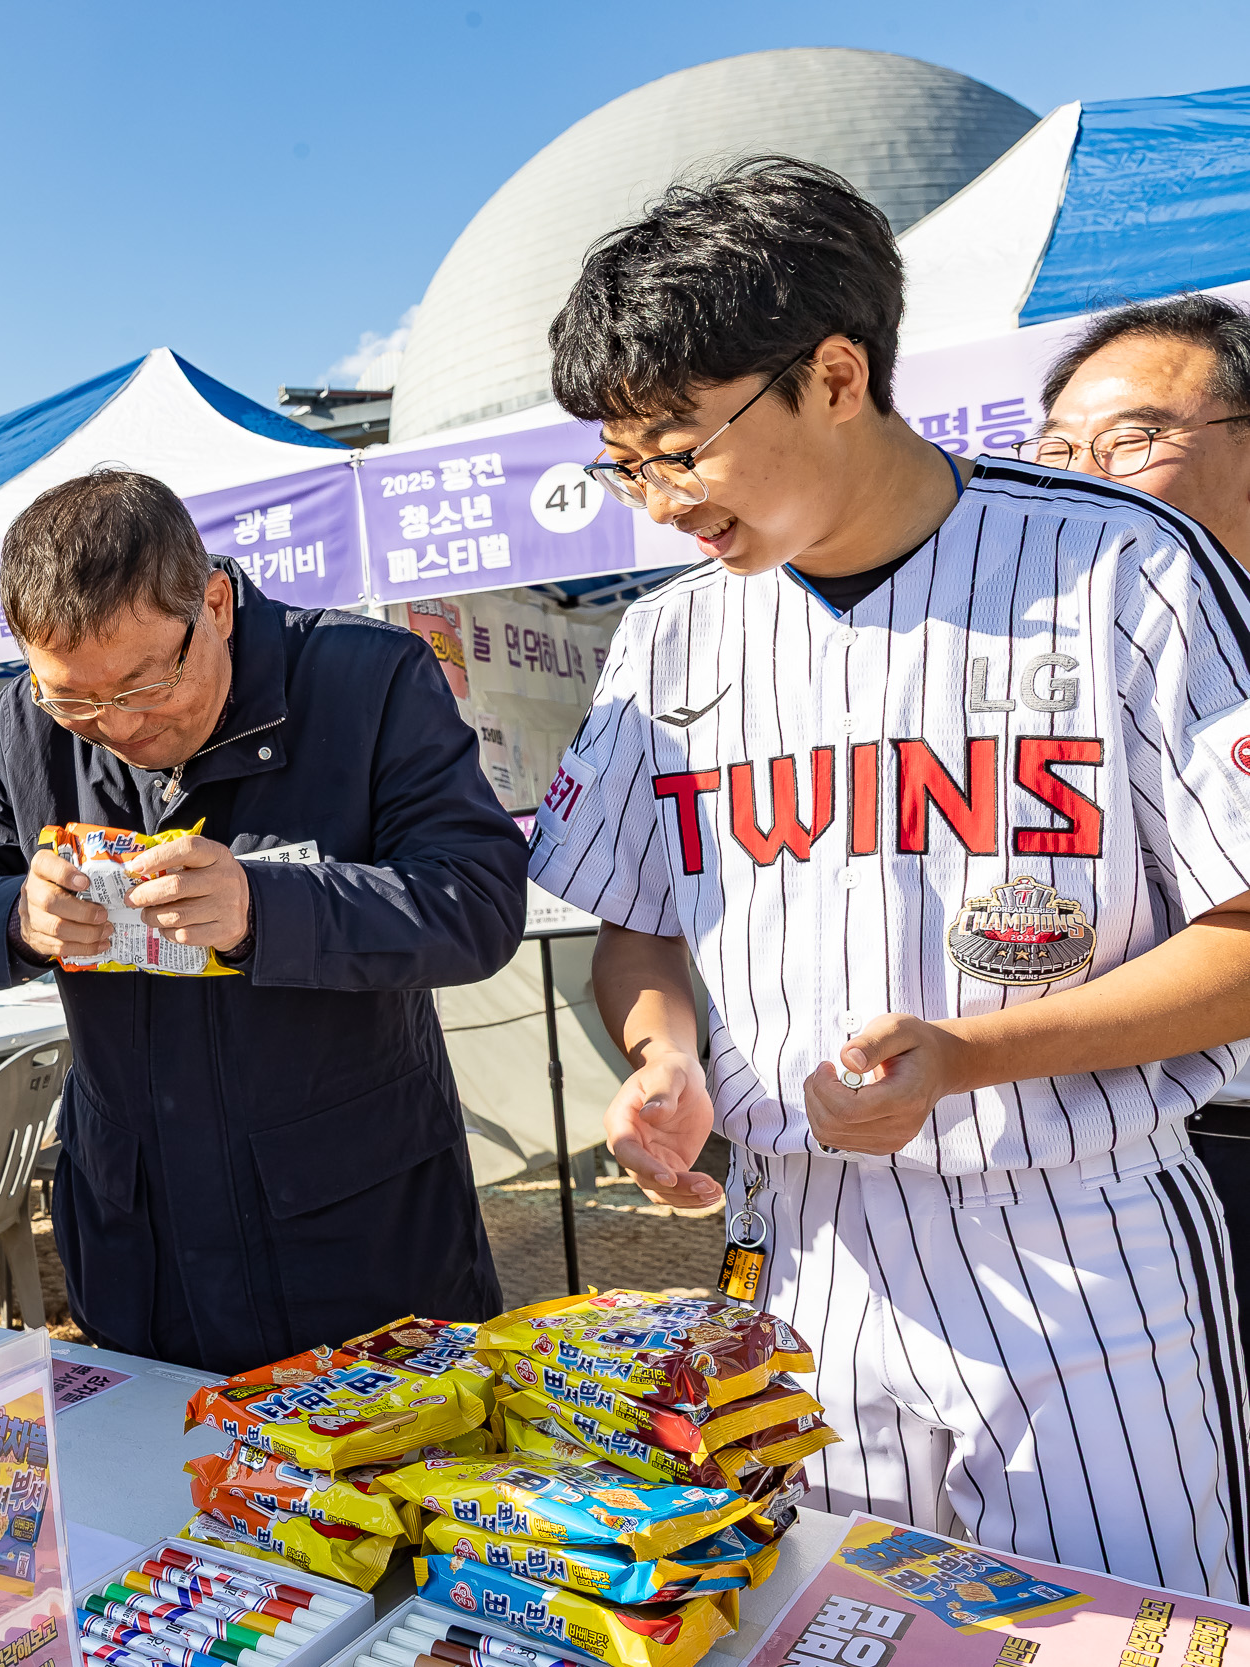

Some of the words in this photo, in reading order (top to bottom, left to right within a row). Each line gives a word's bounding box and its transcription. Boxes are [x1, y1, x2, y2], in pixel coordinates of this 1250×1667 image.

[904, 396, 1034, 457] 평등
[380, 469, 436, 499] 2025
[438, 452, 507, 493] 광진
[544, 480, 589, 513] 41
[233, 503, 294, 546] 광클
[397, 493, 494, 541] 청소년
[234, 540, 326, 588] 람개비
[385, 532, 513, 584] 페스티벌
[967, 651, 1081, 713] LG
[651, 734, 1105, 875] TWINS
[957, 910, 1085, 939] CHAMPIONS
[990, 906, 1025, 914] KOREAN
[1026, 906, 1057, 914] SERIES
[726, 1249, 737, 1266] 400
[744, 1262, 760, 1291] 400
[58, 1375, 111, 1404] 성차별
[543, 1366, 615, 1414] 뿌셔뿌셔
[618, 1401, 650, 1423] 불고기맛
[572, 1411, 652, 1464] 뿌셔뿌셔
[656, 1452, 689, 1475] 불고기맛
[451, 1499, 533, 1535] 뿌셔뿌셔
[485, 1543, 569, 1583] 뿌셔뿌셔
[839, 1530, 958, 1572] 성차별
[881, 1551, 1001, 1599] 뿌셔뿌셔
[483, 1589, 567, 1641] 뿌셔뿌셔
[782, 1595, 916, 1667] 방법
[1126, 1597, 1177, 1654] 생각해보고
[999, 1635, 1041, 1664] 만든
